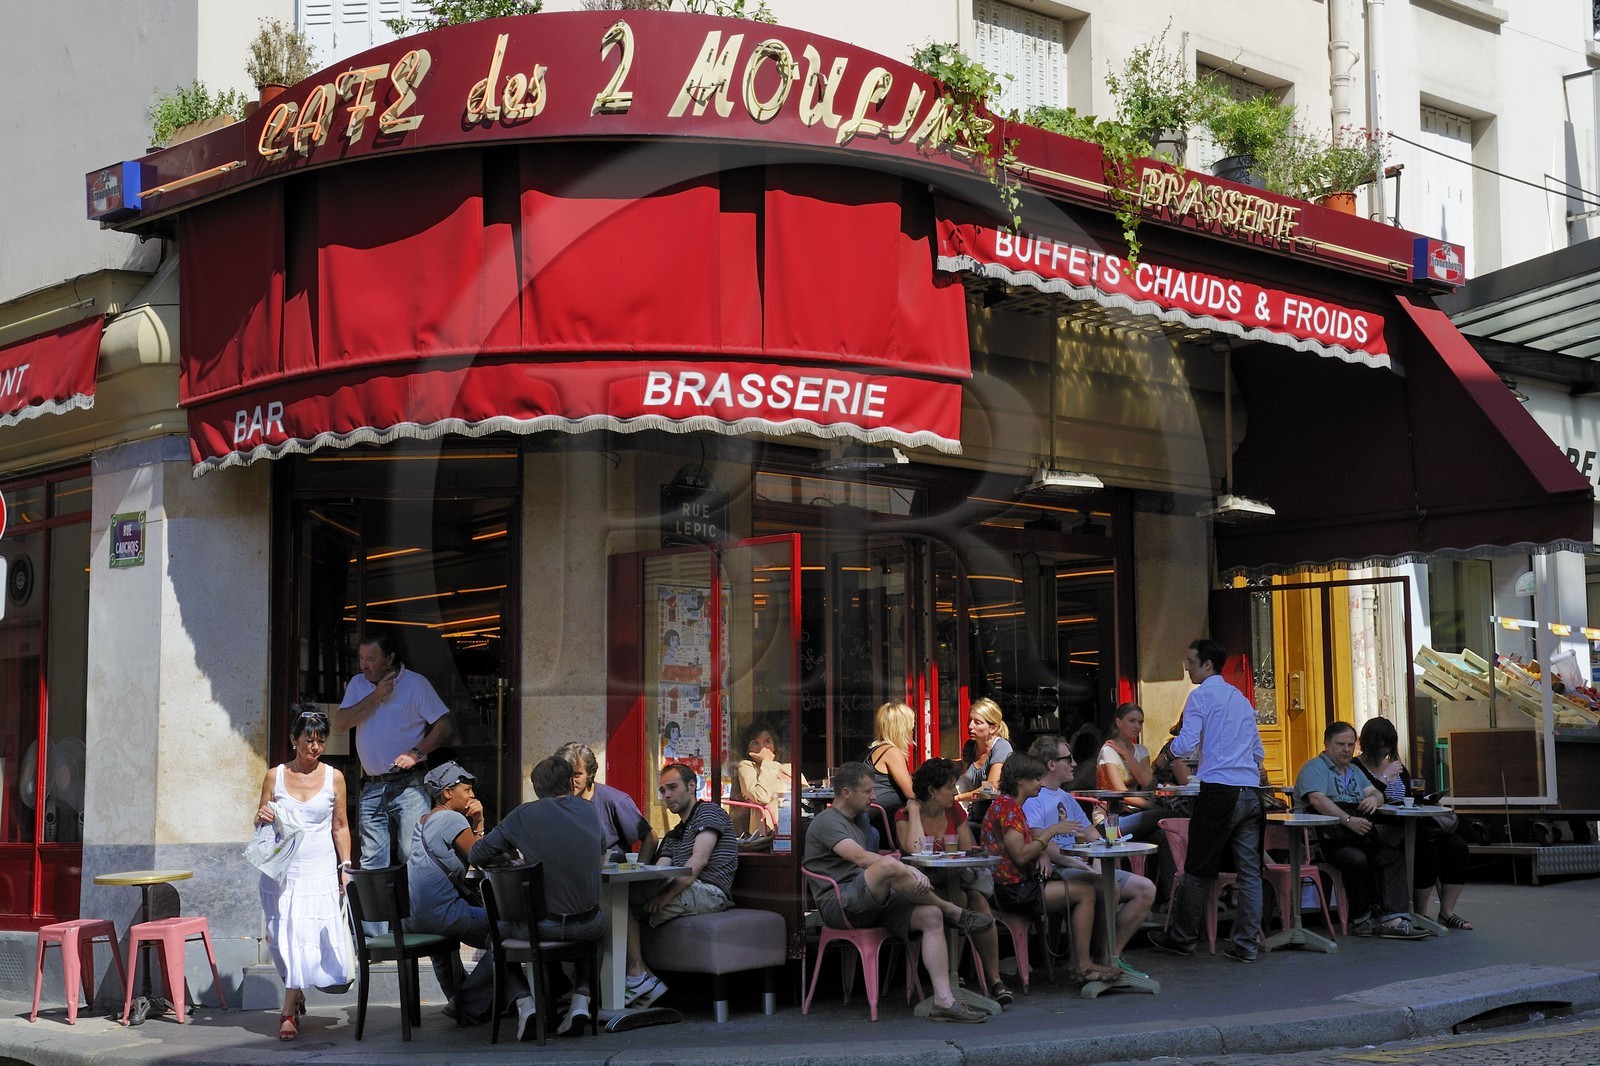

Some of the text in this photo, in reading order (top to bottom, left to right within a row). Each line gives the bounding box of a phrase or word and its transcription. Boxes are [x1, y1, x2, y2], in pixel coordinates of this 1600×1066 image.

[466, 33, 548, 123] des
[591, 19, 634, 118] 2
[1138, 167, 1302, 243] BRASSERIE
[995, 224, 1369, 344] BUFFETS CHAUDS & FROIDS
[0, 363, 30, 399] NT
[643, 371, 889, 419] BRASSERIE
[232, 401, 285, 444] BAR
[676, 520, 717, 538] LEPIC
[682, 502, 710, 519] RUE
